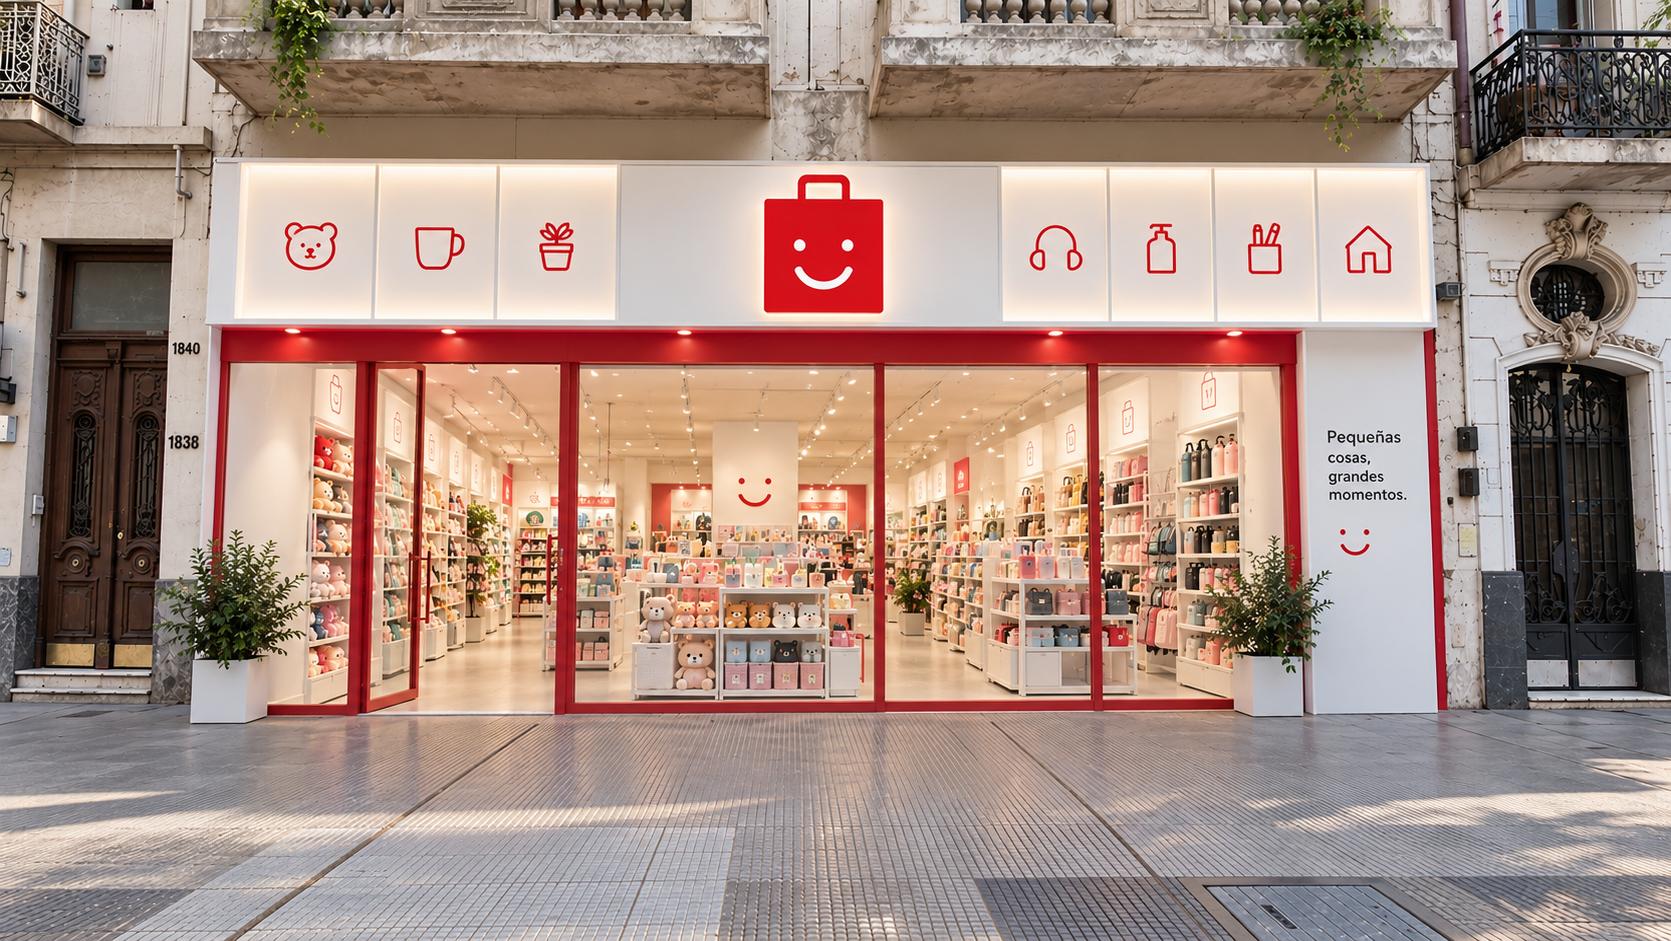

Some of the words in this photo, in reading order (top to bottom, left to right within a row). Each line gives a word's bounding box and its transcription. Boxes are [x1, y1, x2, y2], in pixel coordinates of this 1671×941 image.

[172, 342, 200, 355] 1840
[168, 435, 199, 449] 1838
[1327, 430, 1401, 446] Pequeñas
[1328, 454, 1371, 465] cosas,
[1328, 470, 1384, 485] grandes
[1329, 489, 1407, 500] momentos.
